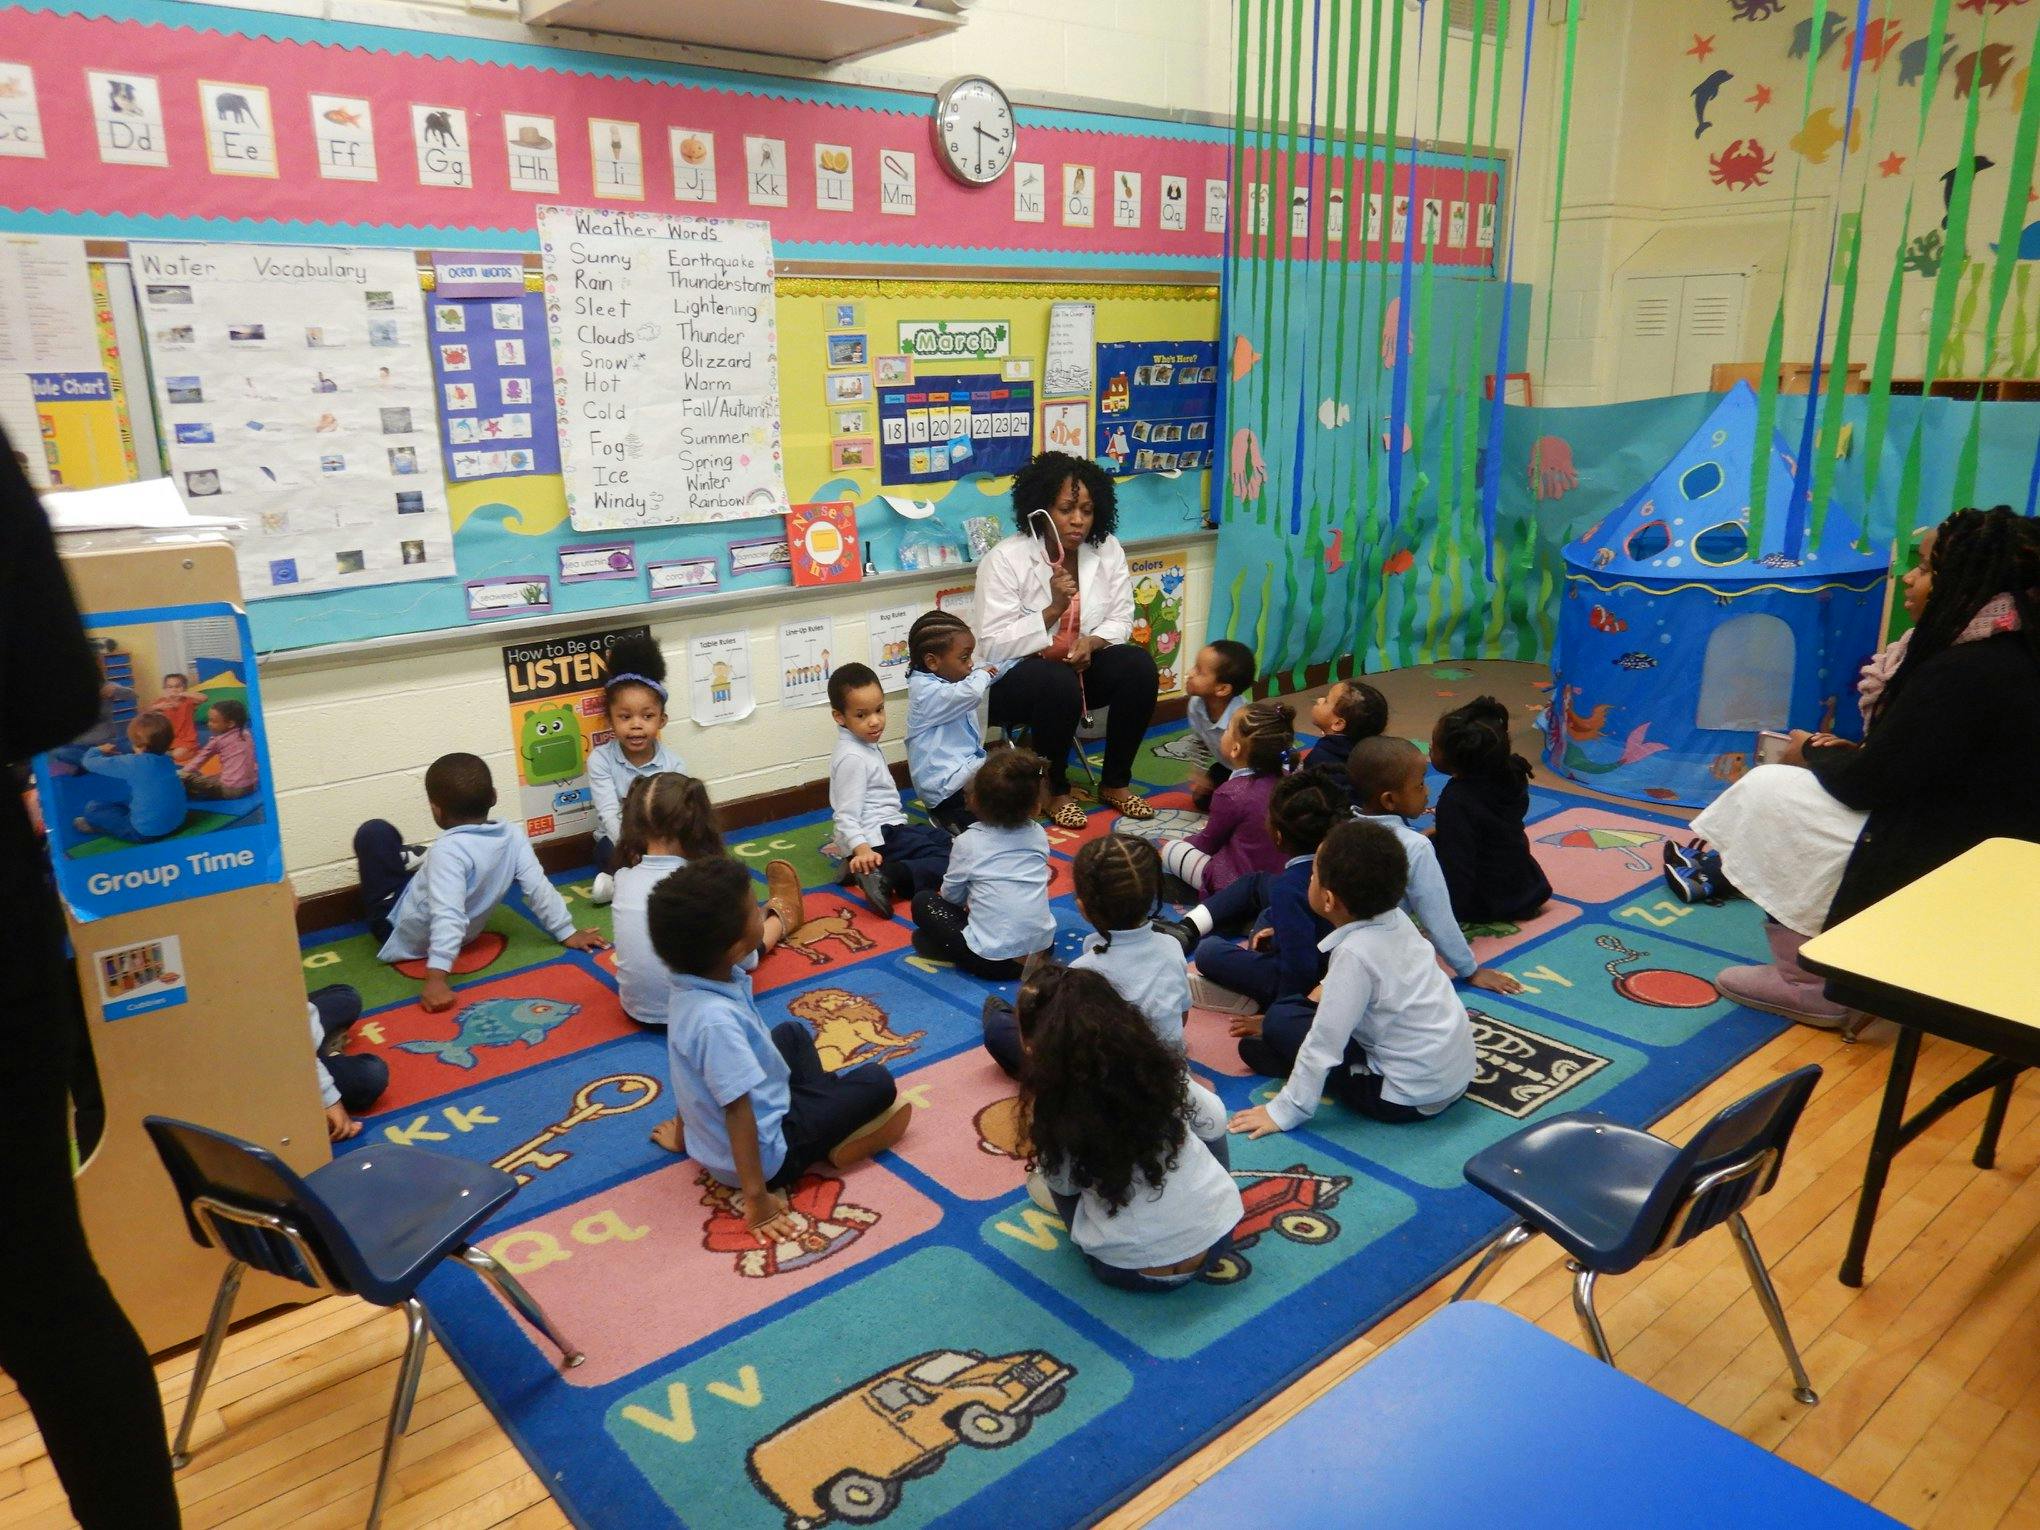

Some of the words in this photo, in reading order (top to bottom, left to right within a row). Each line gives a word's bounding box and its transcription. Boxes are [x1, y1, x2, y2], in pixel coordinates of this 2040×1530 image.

[950, 102, 959, 113] 10
[998, 107, 1006, 118] 2
[108, 120, 152, 152] Dd
[945, 121, 954, 132] 9
[1001, 127, 1010, 139] 3
[223, 131, 259, 161] Ee
[329, 139, 360, 168] Ff
[950, 142, 959, 153] 8
[998, 146, 1005, 156] 4
[425, 148, 465, 187] Gg
[517, 154, 549, 182] Hh
[612, 160, 626, 186] Ii
[960, 157, 968, 168] 7
[974, 163, 982, 175] 6
[988, 160, 996, 170] 5
[686, 167, 706, 200] Jj
[754, 171, 781, 197] Kk
[826, 178, 844, 201] Ll
[883, 183, 914, 205] Mm
[1020, 192, 1039, 213] Nn
[1068, 196, 1089, 217] Oo
[1119, 199, 1135, 226] Pp
[1162, 203, 1184, 230] Qq
[575, 214, 657, 236] Weather
[667, 223, 718, 242] Words
[569, 242, 632, 271] Sunny
[668, 249, 755, 277] Earthquake
[141, 254, 216, 278] Water
[252, 256, 368, 285] Vocabulary
[574, 269, 613, 291] Rain
[667, 271, 772, 294] Thunderstorm
[574, 296, 631, 319] Sleet
[673, 295, 757, 322] Lightening
[577, 325, 635, 345] Clouds
[676, 319, 745, 345] Thunder
[915, 327, 998, 355] March
[581, 350, 628, 370] Snow
[681, 347, 752, 369] Blizzard
[1153, 355, 1176, 364] Who's
[1176, 354, 1198, 363] Here?
[62, 378, 105, 397] Chart
[584, 372, 621, 393] Hot
[684, 372, 732, 392] Warm
[582, 400, 626, 421] Cold
[1061, 407, 1069, 419] F
[888, 423, 902, 439] 18
[911, 421, 925, 438] 19
[933, 420, 949, 437] 20
[953, 418, 967, 435] 21
[975, 419, 990, 435] 22
[995, 417, 1009, 433] 23
[1013, 416, 1028, 433] 24
[590, 430, 626, 461] Fog
[680, 427, 749, 445] Summer
[1711, 428, 1729, 449] 9
[678, 450, 733, 472] Spring
[592, 466, 629, 487] Ice
[686, 475, 731, 492] Winter
[594, 491, 646, 517] Windy
[688, 492, 745, 509] Rainbow
[1640, 499, 1655, 517] 6
[1131, 560, 1164, 573] Colors
[480, 590, 518, 603] seaweed
[508, 649, 544, 664] How
[546, 644, 565, 657] to
[567, 640, 587, 655] Be
[589, 640, 601, 651] a
[528, 816, 554, 830] FEET
[732, 840, 797, 858] Cc
[87, 858, 181, 897] Group
[187, 847, 256, 878] Time
[1619, 901, 1695, 927] Zz
[383, 1105, 500, 1146] Kk
[621, 1364, 763, 1444] Vv
